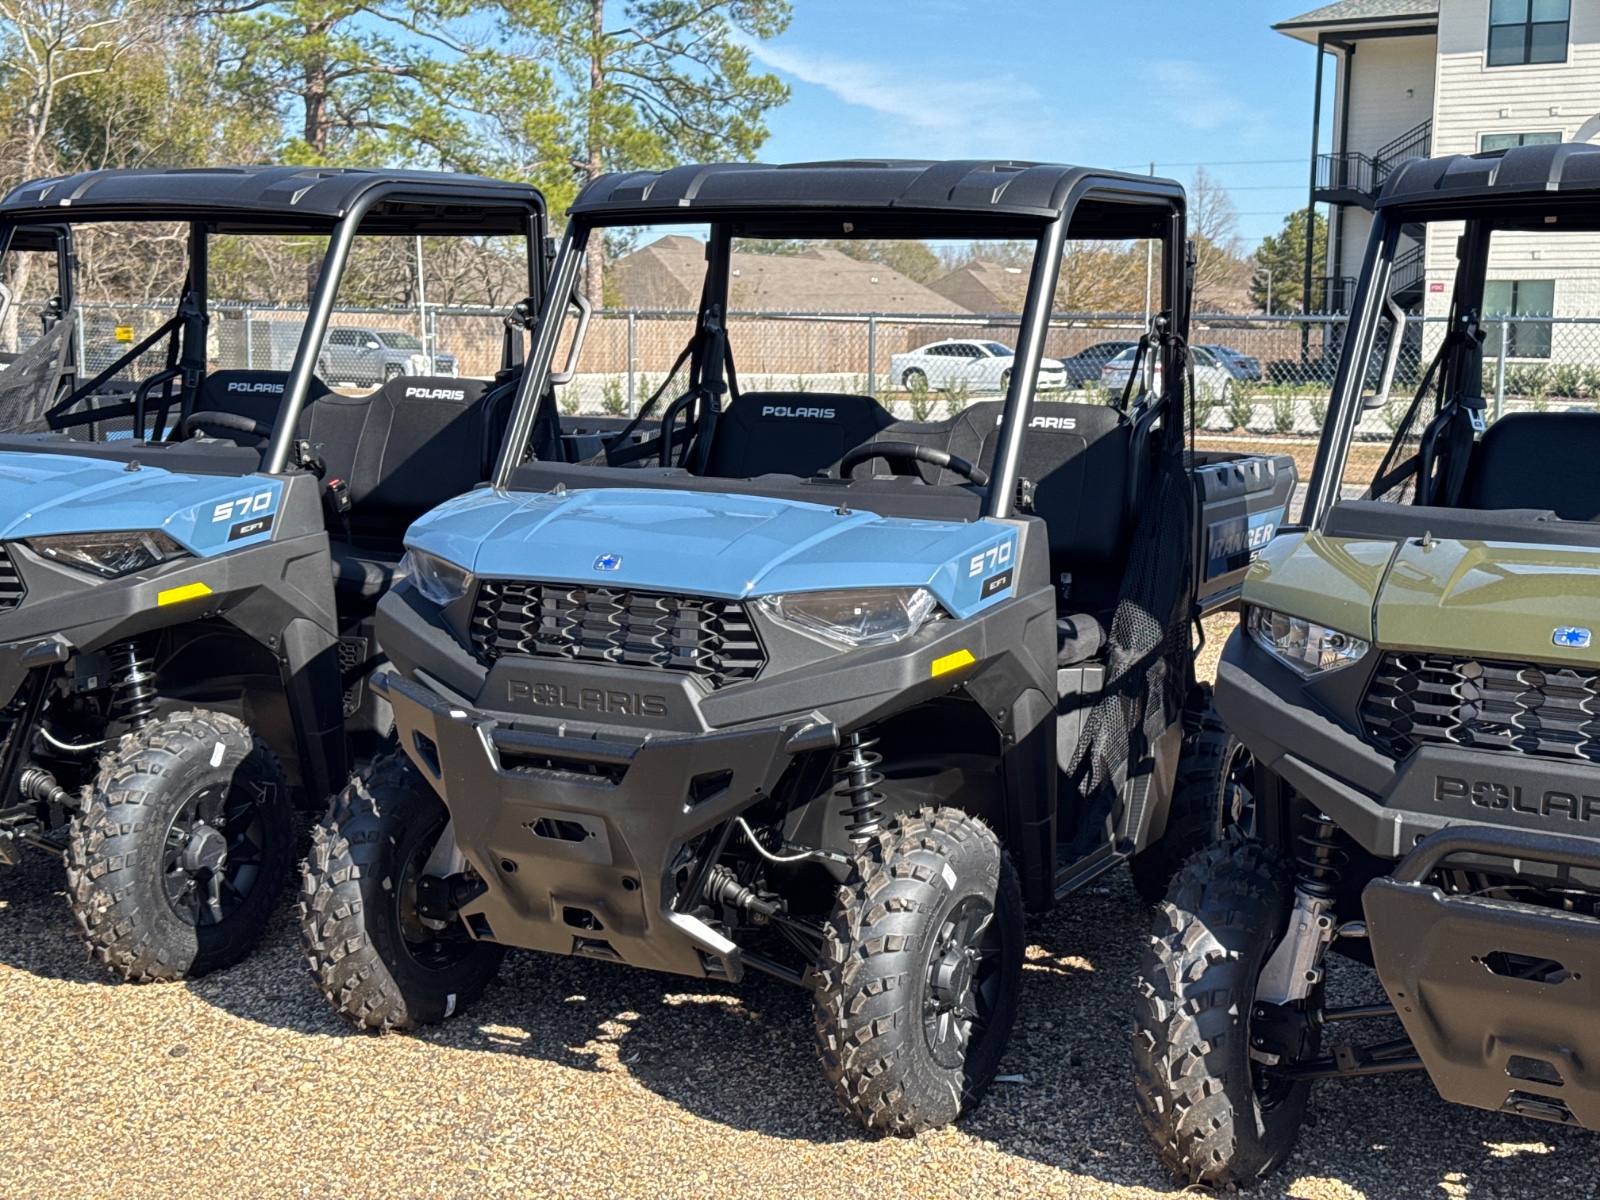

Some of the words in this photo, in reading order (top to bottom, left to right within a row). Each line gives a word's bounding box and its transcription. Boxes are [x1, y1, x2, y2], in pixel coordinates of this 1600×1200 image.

[227, 382, 284, 393] POLARIS
[405, 387, 464, 401] POLARIS
[762, 406, 836, 419] POLARIS
[212, 491, 272, 523] 570
[239, 521, 264, 534] EFI
[1211, 523, 1274, 560] RANGER
[968, 540, 1012, 578] 570
[989, 576, 1006, 590] EFI
[507, 679, 669, 718] POLARIS
